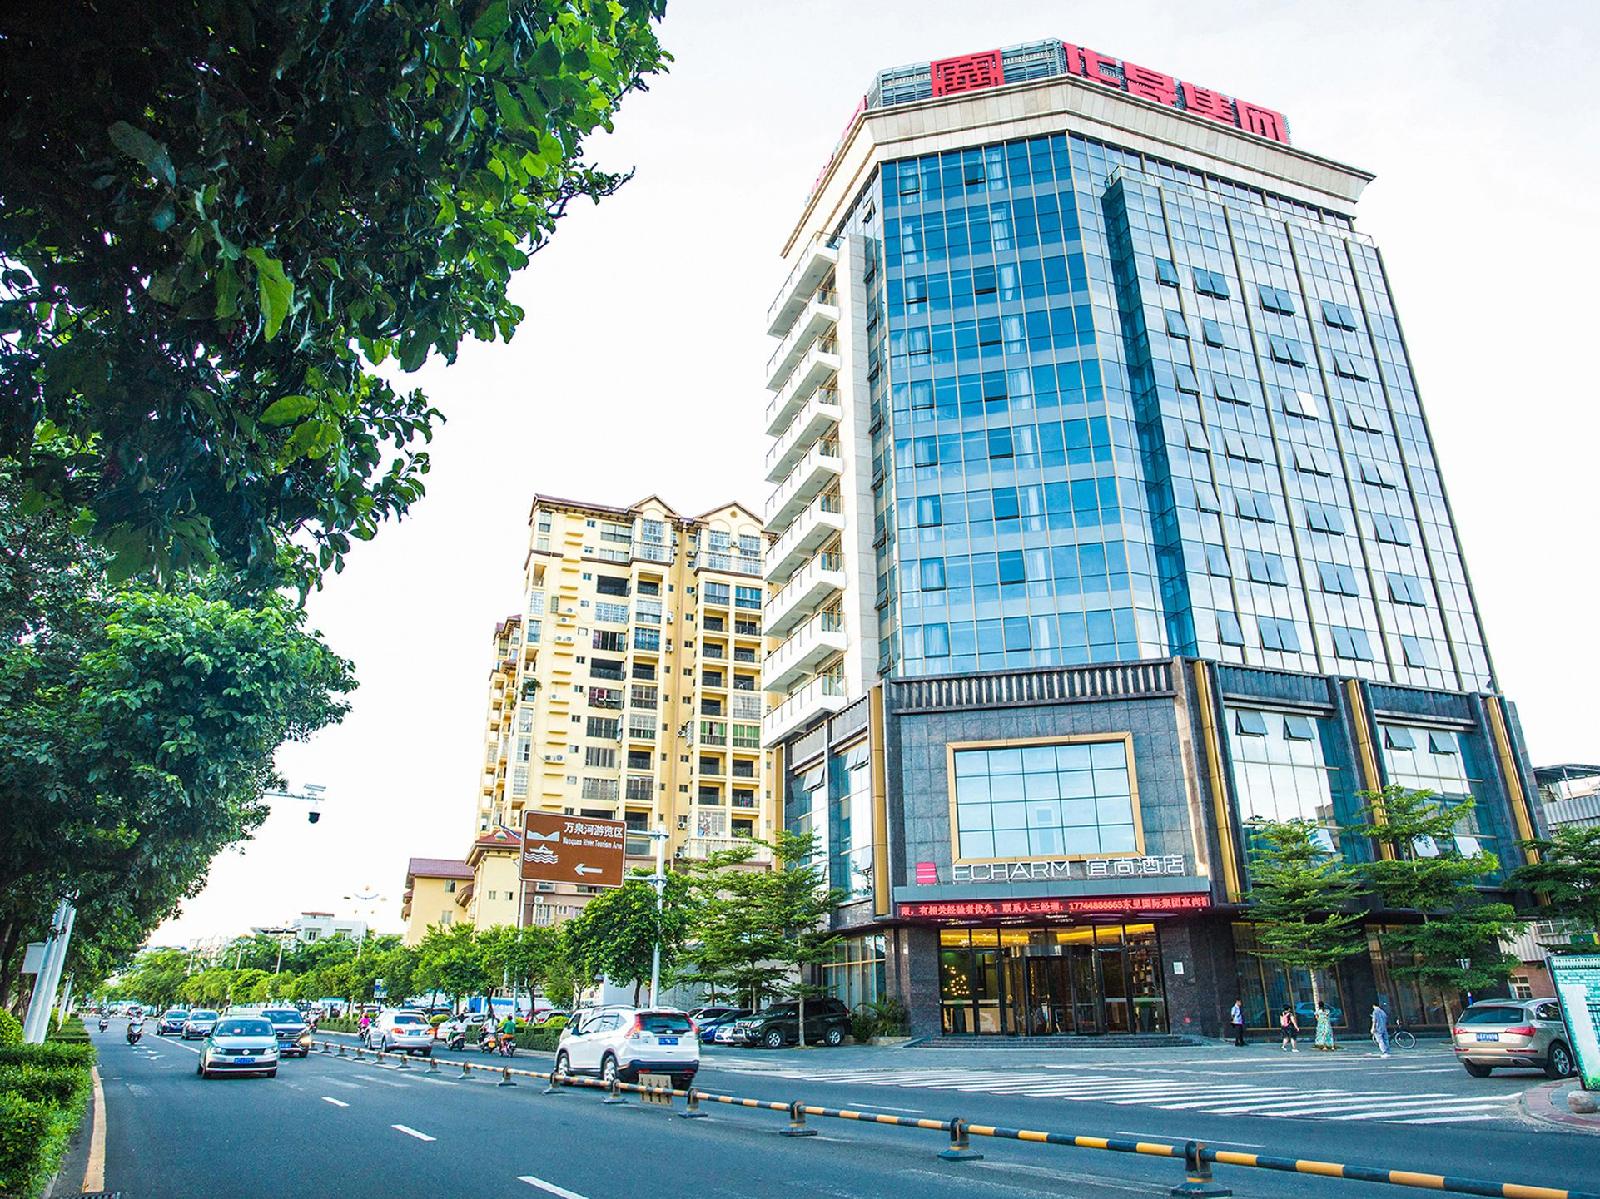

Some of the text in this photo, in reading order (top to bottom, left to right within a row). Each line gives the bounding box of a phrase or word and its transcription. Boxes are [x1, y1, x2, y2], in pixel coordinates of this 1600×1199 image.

[563, 821, 623, 839] 万泉河游览区
[952, 861, 1071, 882] ECHARM
[1086, 854, 1185, 877] 宜尚酒店
